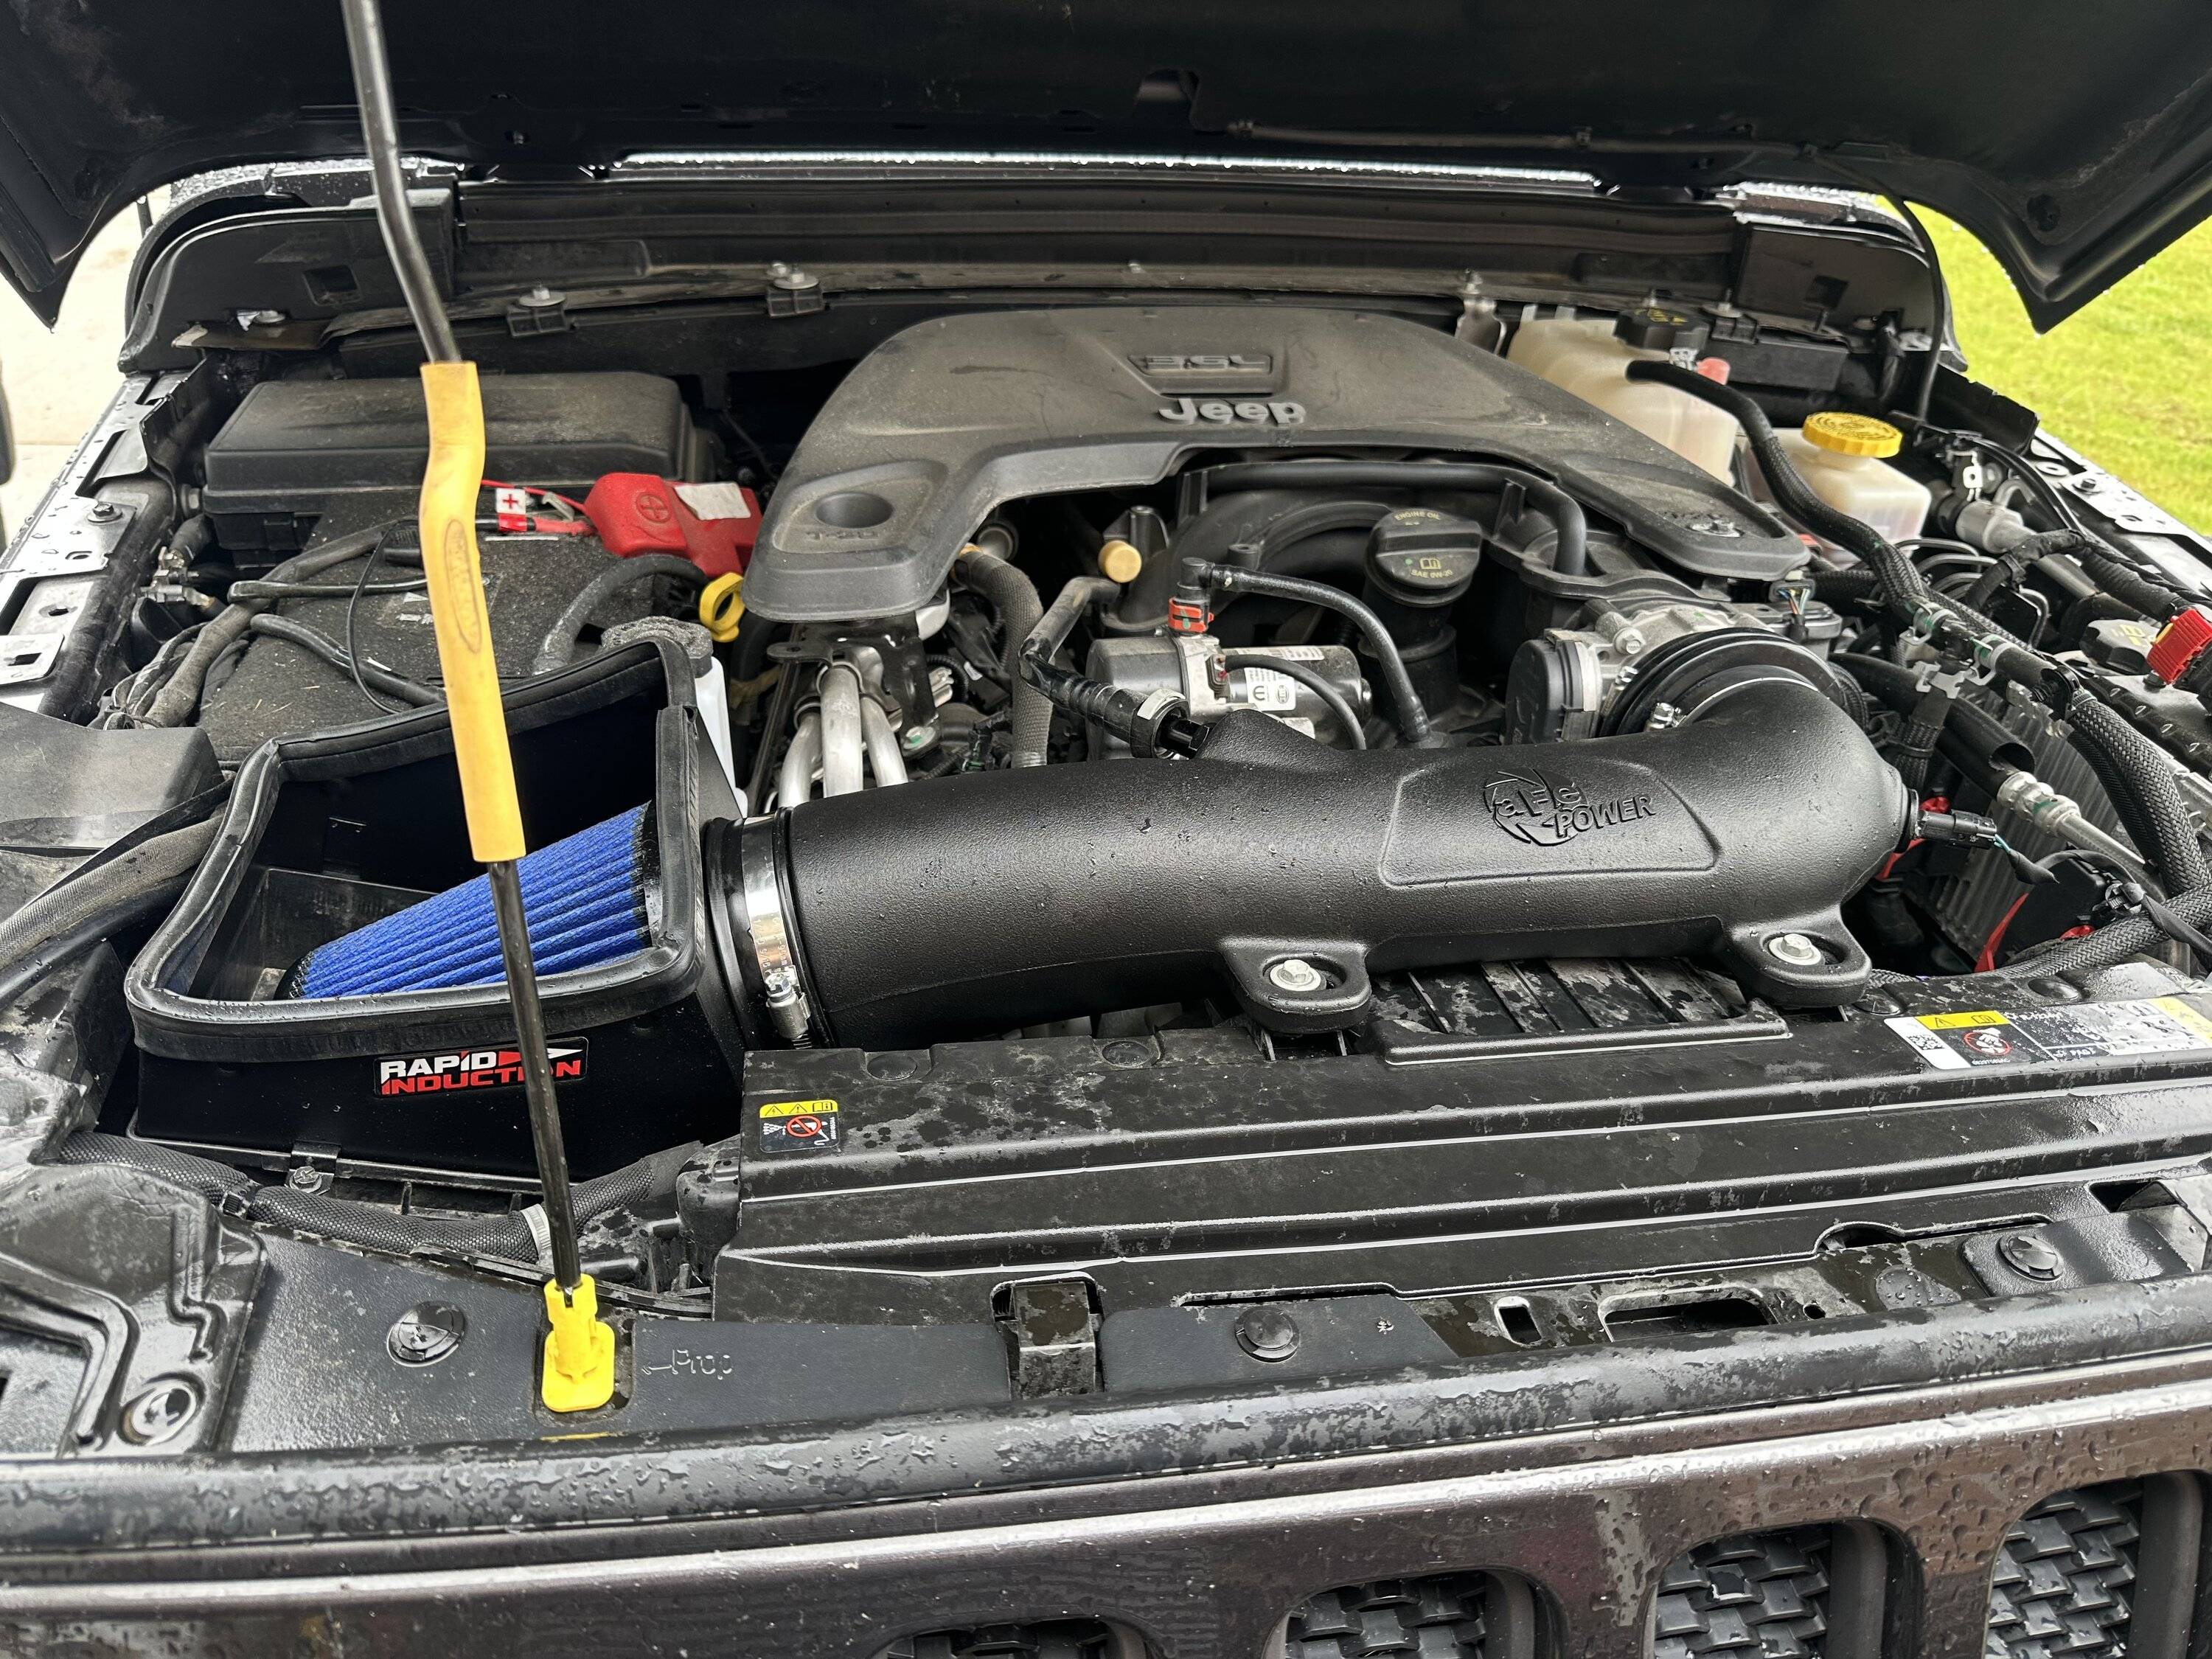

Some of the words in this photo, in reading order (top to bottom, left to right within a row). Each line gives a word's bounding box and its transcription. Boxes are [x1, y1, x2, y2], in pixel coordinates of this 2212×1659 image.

[1157, 397, 1307, 425] Jeep
[1394, 511, 1425, 521] ENGINE
[1427, 512, 1442, 521] OIL
[1410, 568, 1428, 579] SAE
[1430, 568, 1454, 579] 0W-20
[1554, 794, 1657, 839] POWER
[380, 1050, 498, 1085] RAPID
[381, 1060, 581, 1096] INDUCTIN
[671, 1348, 733, 1380] Prop
